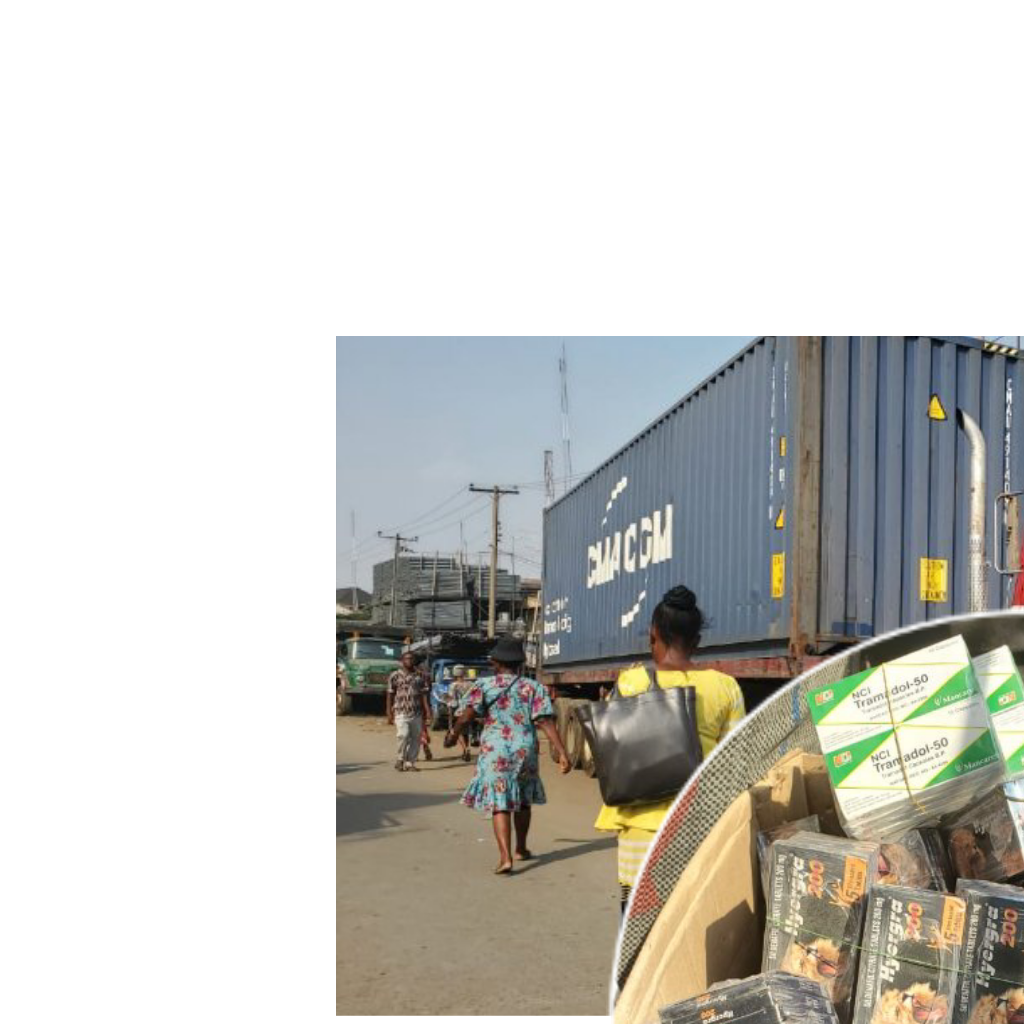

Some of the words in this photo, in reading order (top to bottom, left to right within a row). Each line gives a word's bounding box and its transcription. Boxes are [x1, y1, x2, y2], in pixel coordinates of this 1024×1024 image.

[852, 687, 871, 700] NCI
[871, 749, 890, 763] NCI
[808, 858, 825, 899] 200
[846, 889, 859, 903] 5
[880, 898, 905, 983] Hyergra
[904, 902, 922, 942] 200
[944, 931, 956, 941] 5
[1000, 907, 1018, 948] 200
[975, 905, 999, 988] Hyergra
